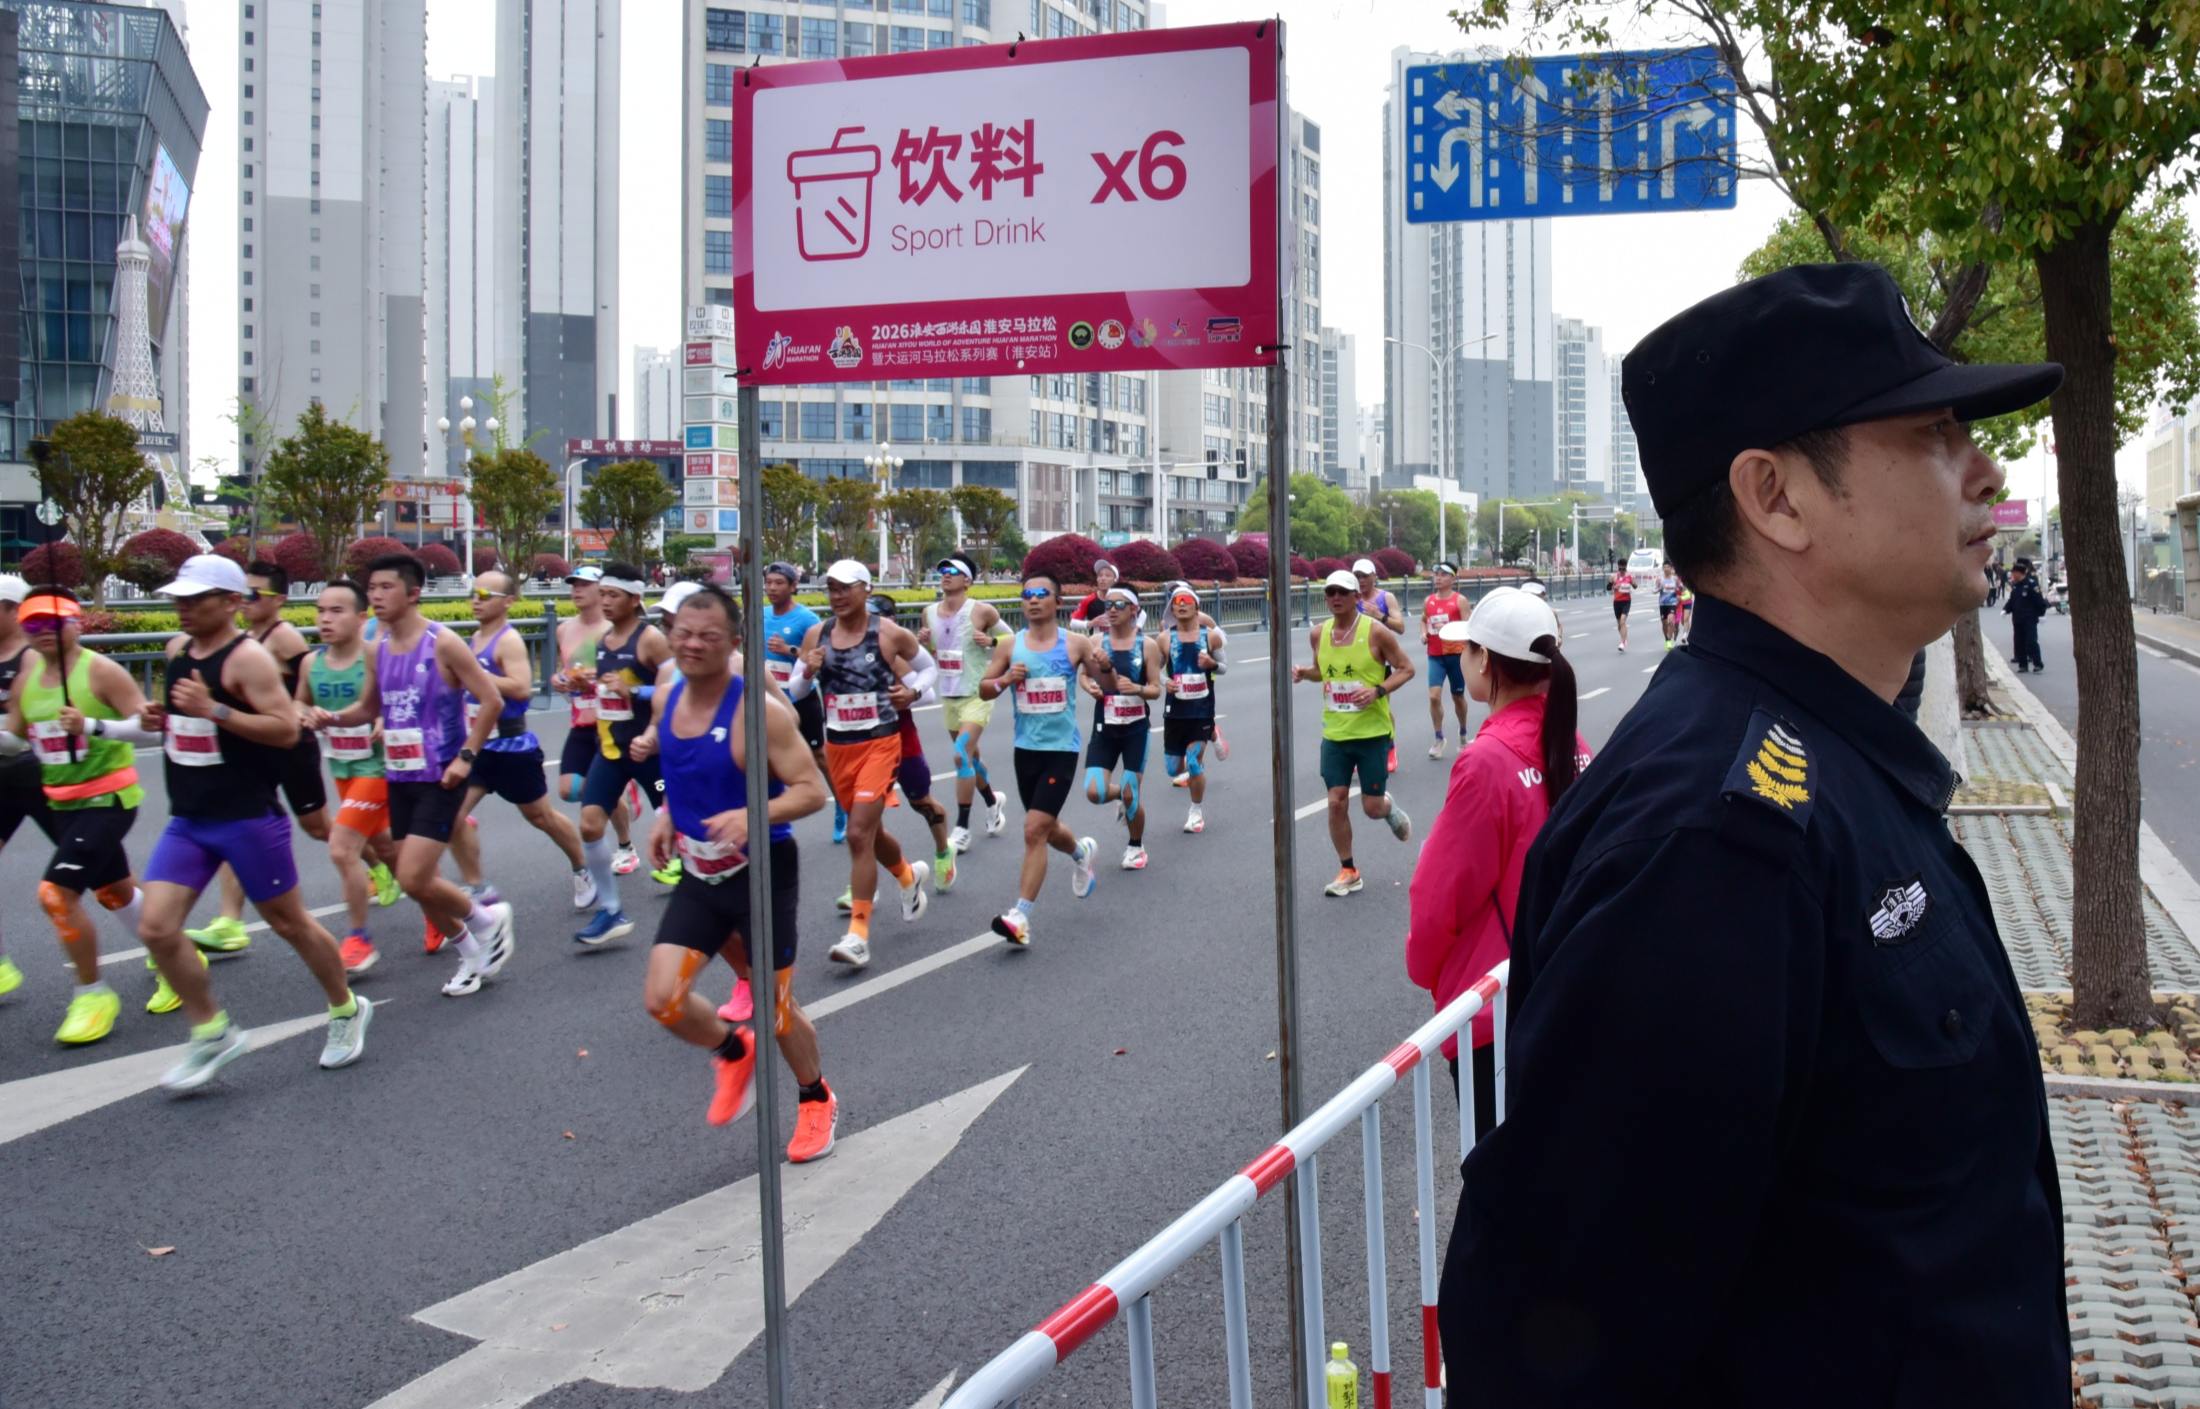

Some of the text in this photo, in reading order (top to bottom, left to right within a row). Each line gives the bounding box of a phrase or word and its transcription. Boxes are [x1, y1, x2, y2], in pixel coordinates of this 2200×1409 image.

[891, 119, 1044, 206] 饮料
[1090, 130, 1187, 204] x6
[891, 216, 1046, 256] Sport Drink
[952, 337, 991, 346] ADVENTURE
[786, 355, 819, 363] MARATHON
[1027, 690, 1063, 704] 11378
[837, 706, 874, 721] 11028
